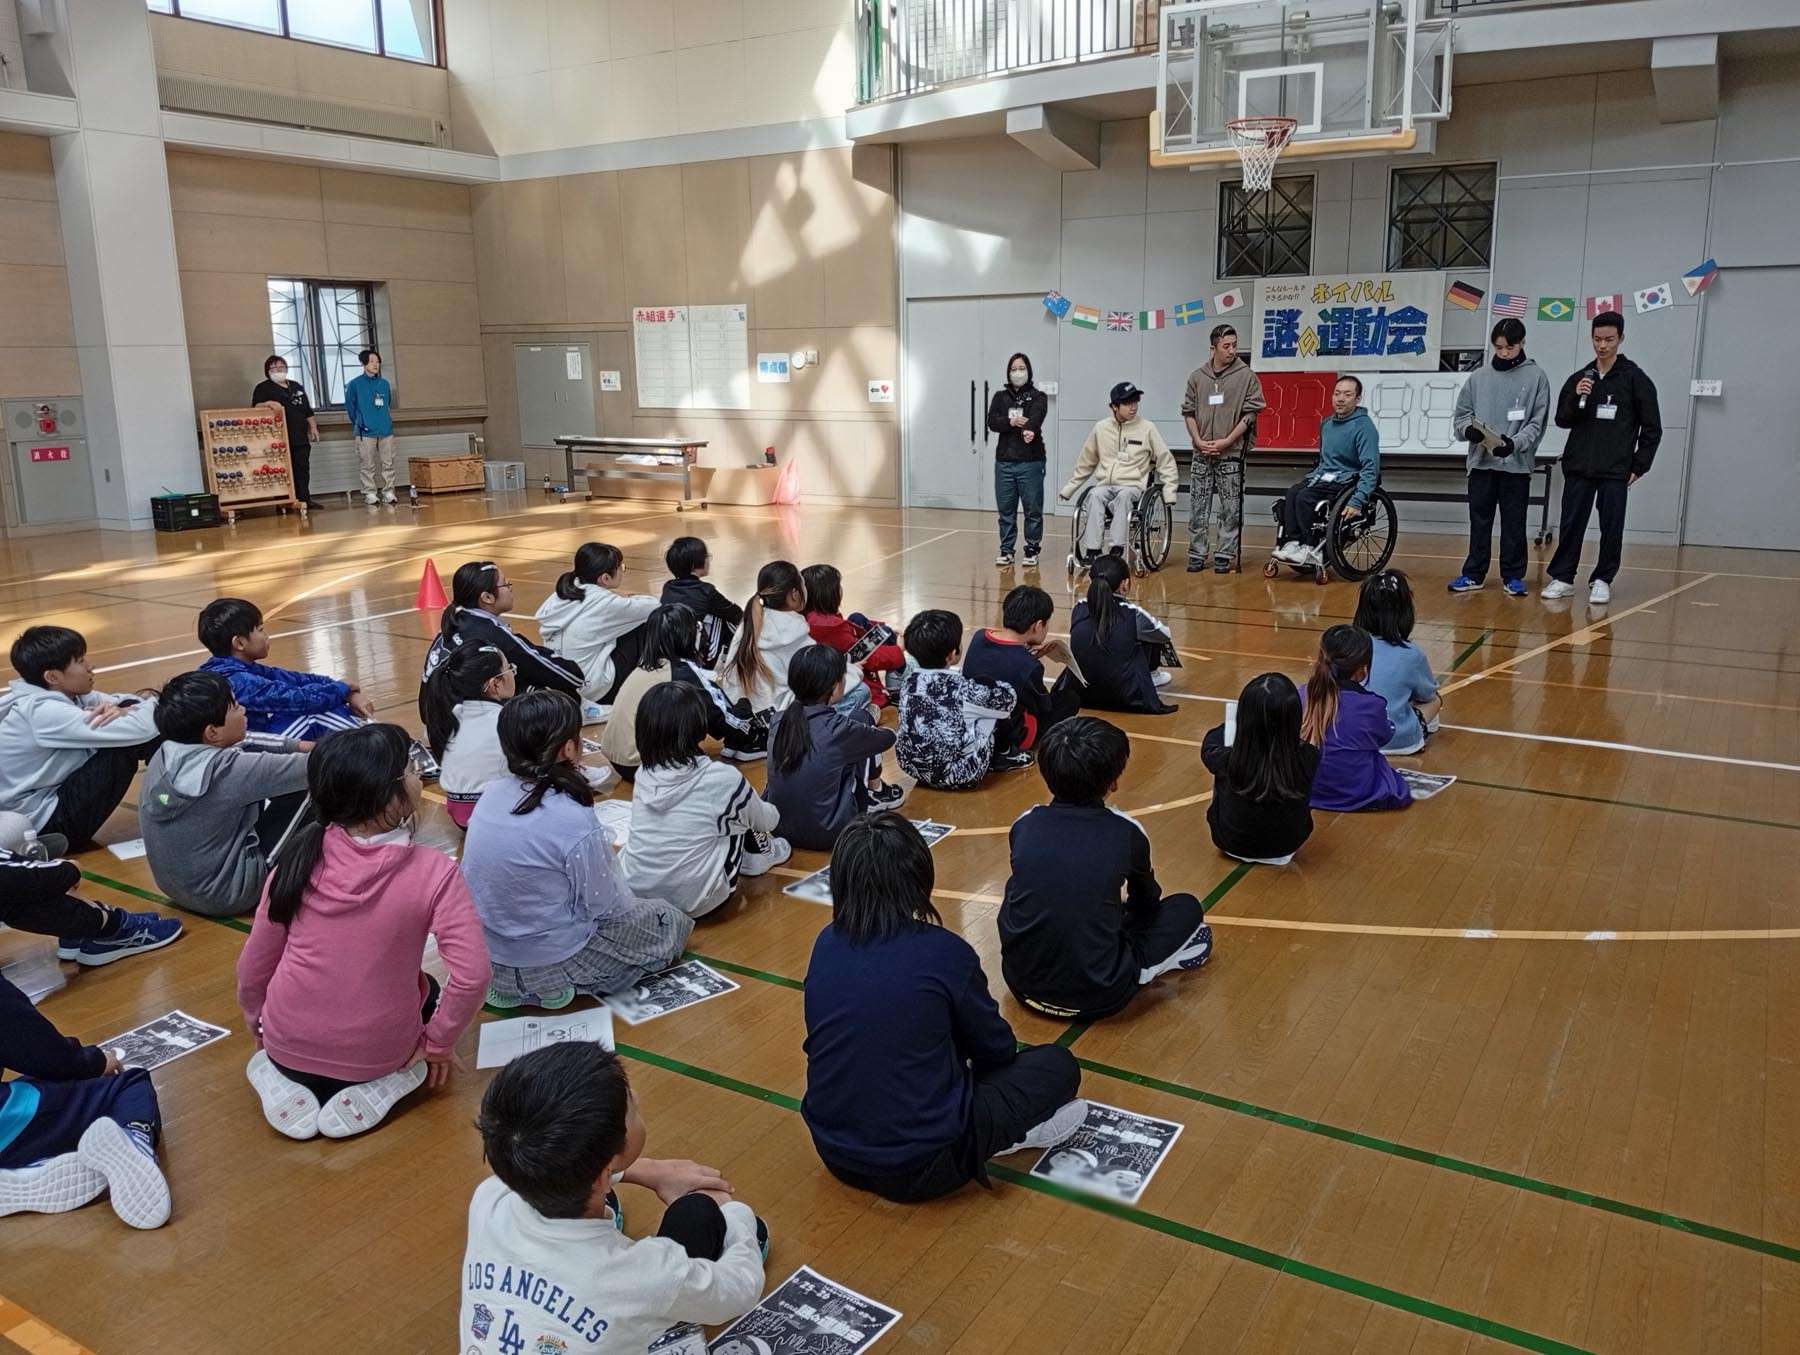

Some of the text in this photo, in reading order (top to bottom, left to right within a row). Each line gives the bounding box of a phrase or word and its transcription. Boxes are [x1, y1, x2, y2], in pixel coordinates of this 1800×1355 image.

[1262, 305, 1429, 358] 謎の運動会
[468, 1262, 496, 1291] LOS
[499, 1265, 609, 1344] ANGELES
[498, 1308, 525, 1355] LA
